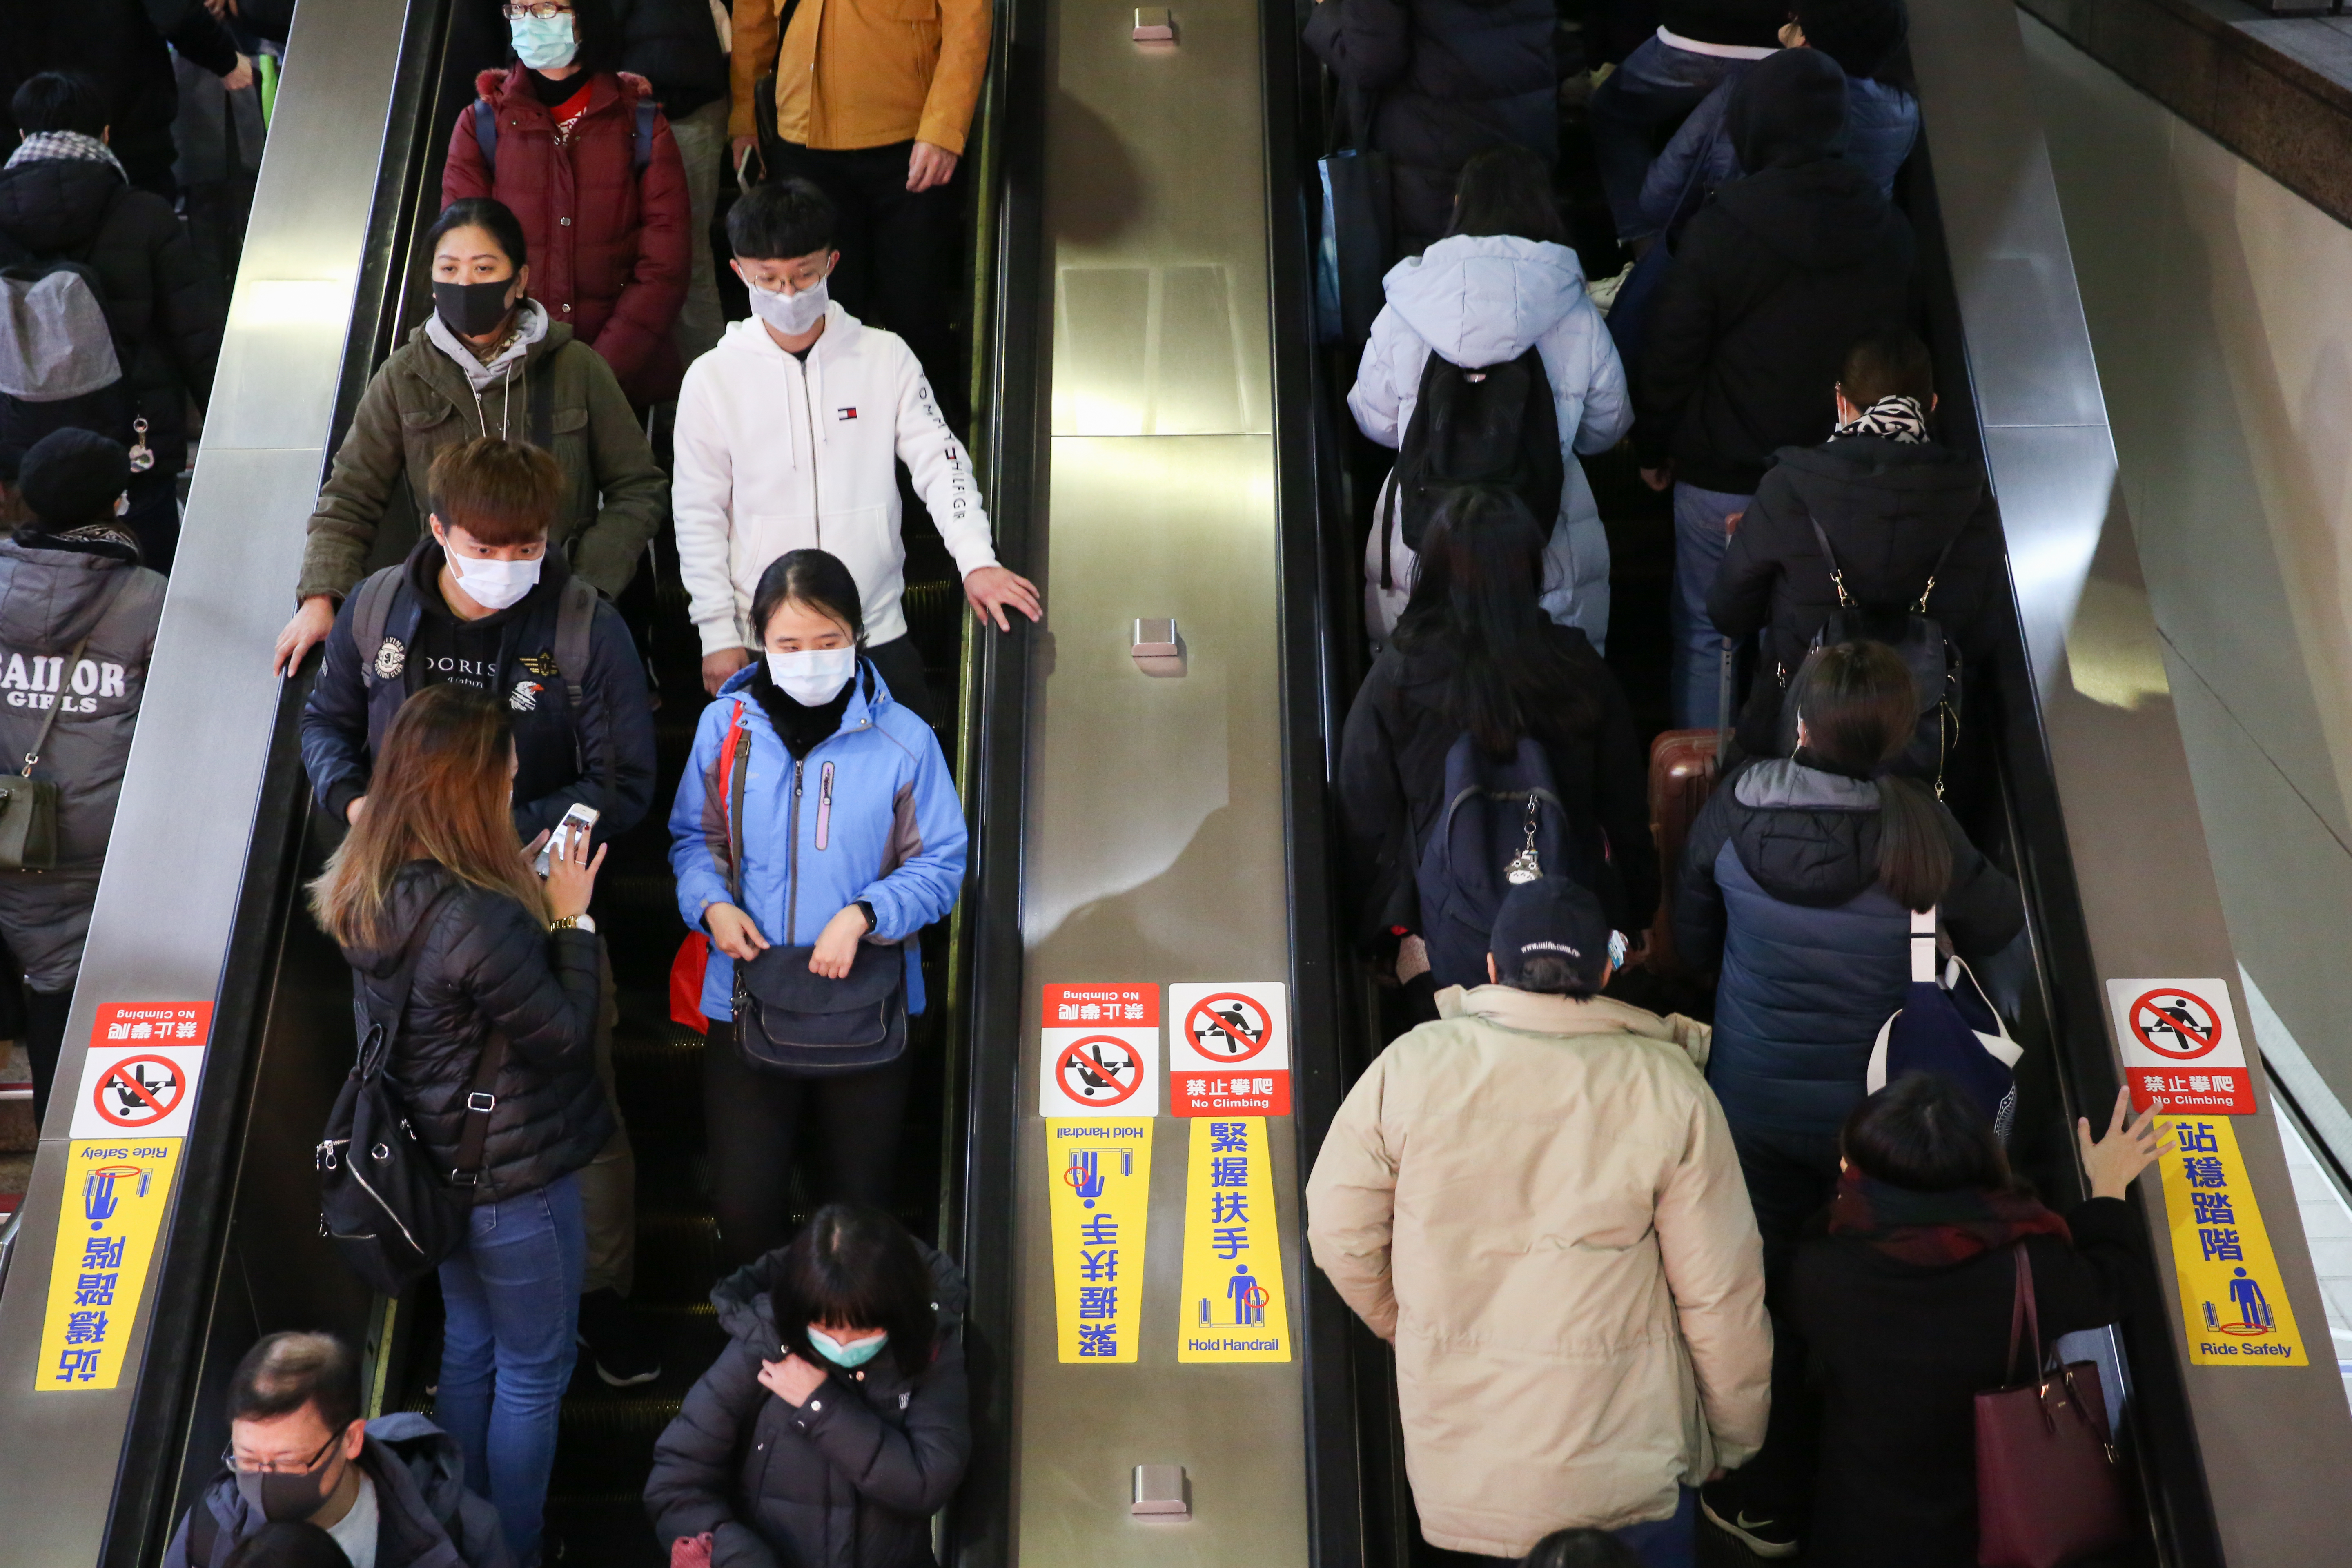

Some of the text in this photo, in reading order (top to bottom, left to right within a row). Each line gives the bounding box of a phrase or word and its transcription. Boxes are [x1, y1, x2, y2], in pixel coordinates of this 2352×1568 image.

[0, 653, 125, 697] AILOR
[7, 691, 97, 713] GIRLS
[1063, 991, 1139, 1000] No Climbing
[117, 1010, 195, 1020] No Climbing
[1058, 1003, 1144, 1020] 禁止攀爬
[107, 1022, 197, 1040] 禁止攀爬
[1187, 1078, 1273, 1096] 禁止攀爬
[2144, 1075, 2235, 1092] 禁止攀爬
[1191, 1098, 1269, 1109] No Climbing
[2152, 1096, 2233, 1106] No Climbing
[1057, 1127, 1143, 1138] Hold Handrail
[81, 1147, 168, 1159] Ride Safely
[1210, 1122, 1250, 1259] 緊握扶手
[2176, 1122, 2243, 1261] 站穩踏階
[1078, 1214, 1118, 1356] 緊握扶手
[56, 1236, 126, 1382] 站穩踏階
[1189, 1339, 1279, 1351] Hold Handrail
[2201, 1343, 2292, 1357] Ride Safely
